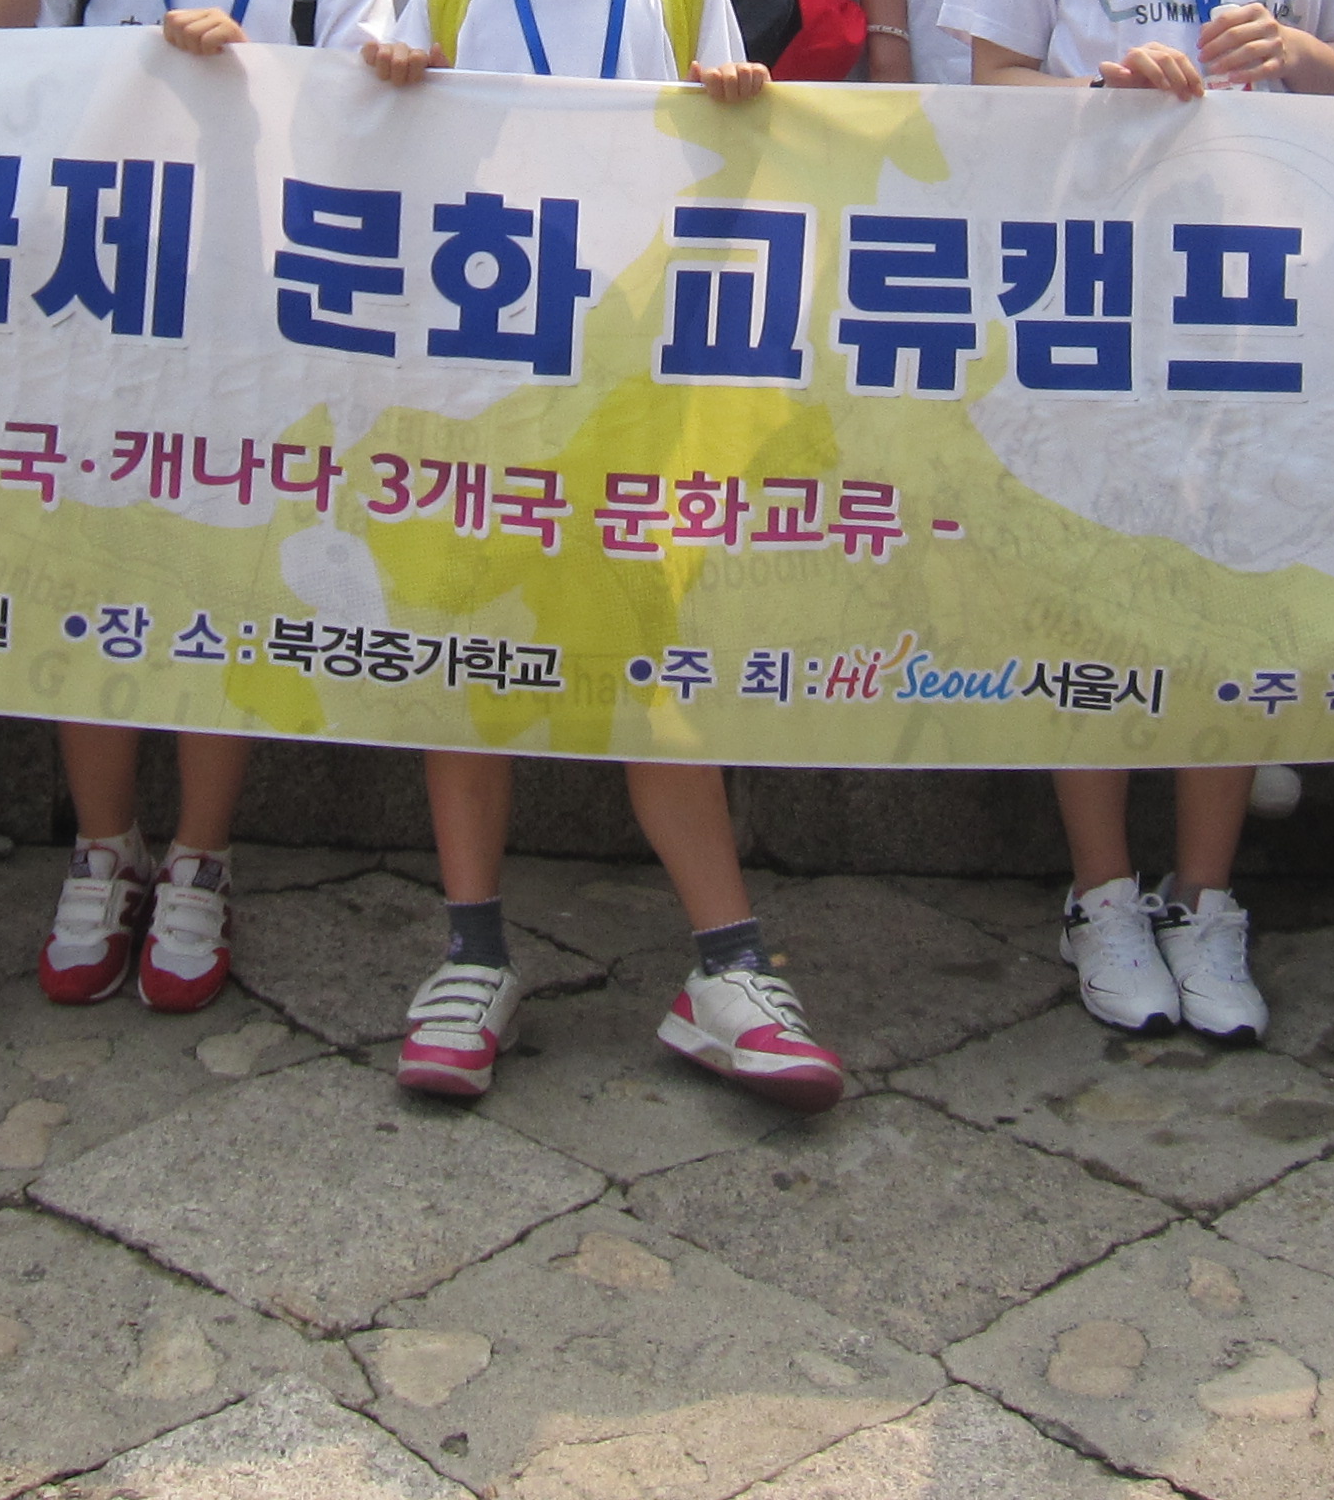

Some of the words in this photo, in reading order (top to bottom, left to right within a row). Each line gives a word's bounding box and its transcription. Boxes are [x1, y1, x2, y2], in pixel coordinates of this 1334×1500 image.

[1135, 0, 1195, 25] SUMM
[274, 177, 592, 377] 문화
[660, 206, 1303, 392] 교류캠프
[368, 453, 569, 548] 3개국
[593, 471, 906, 558] 문화교류
[903, 653, 1015, 702] Seoul
[1021, 660, 1165, 716] 서울시
